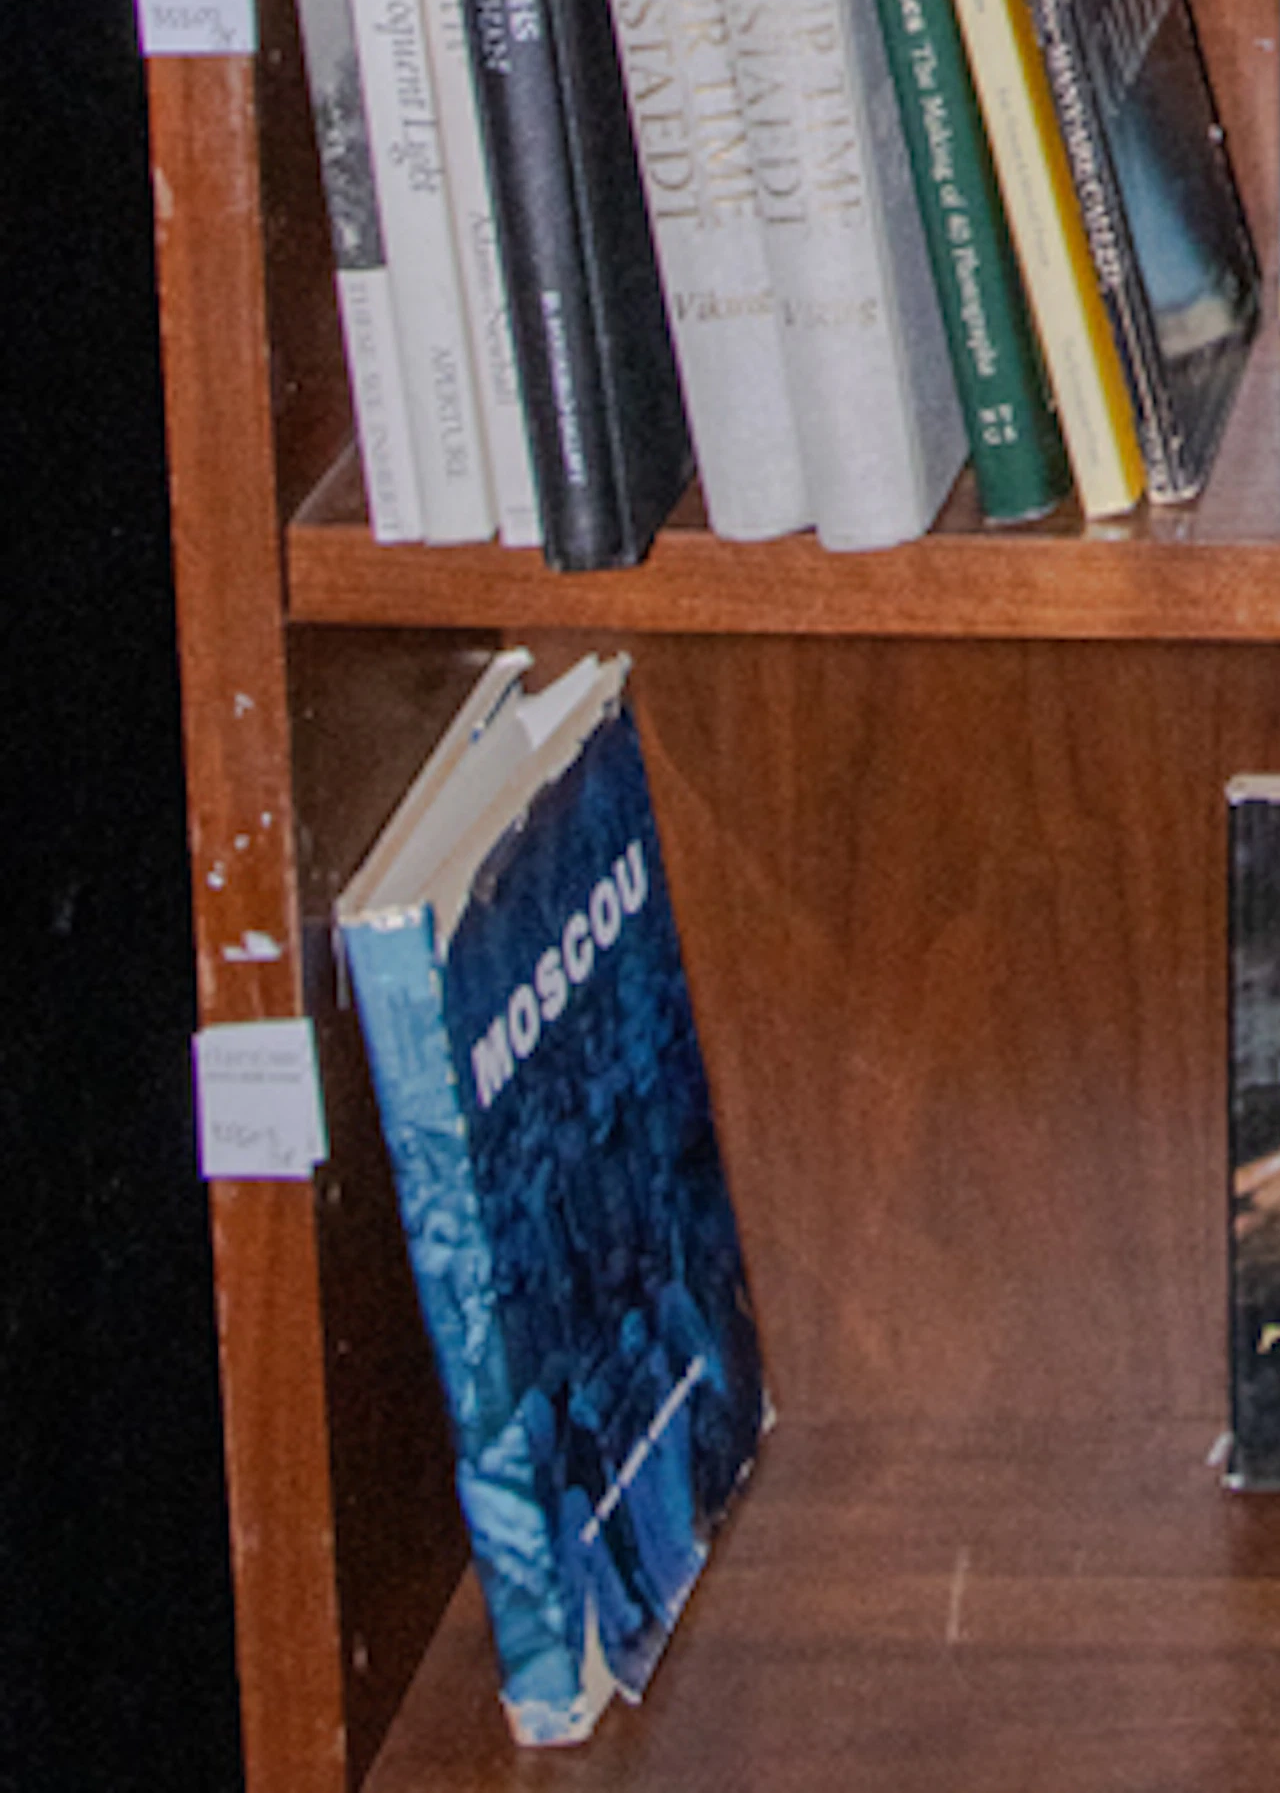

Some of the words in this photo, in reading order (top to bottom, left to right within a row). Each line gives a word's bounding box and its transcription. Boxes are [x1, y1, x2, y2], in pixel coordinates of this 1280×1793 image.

[907, 38, 943, 89] The
[385, 113, 443, 200] Light
[685, 66, 769, 229] TIME
[797, 73, 877, 232] TIME
[914, 90, 965, 183] Making
[939, 180, 971, 212] of
[945, 243, 1008, 380] Photographs
[425, 343, 475, 488] APERTURE
[470, 839, 653, 1111] MOSCOU
